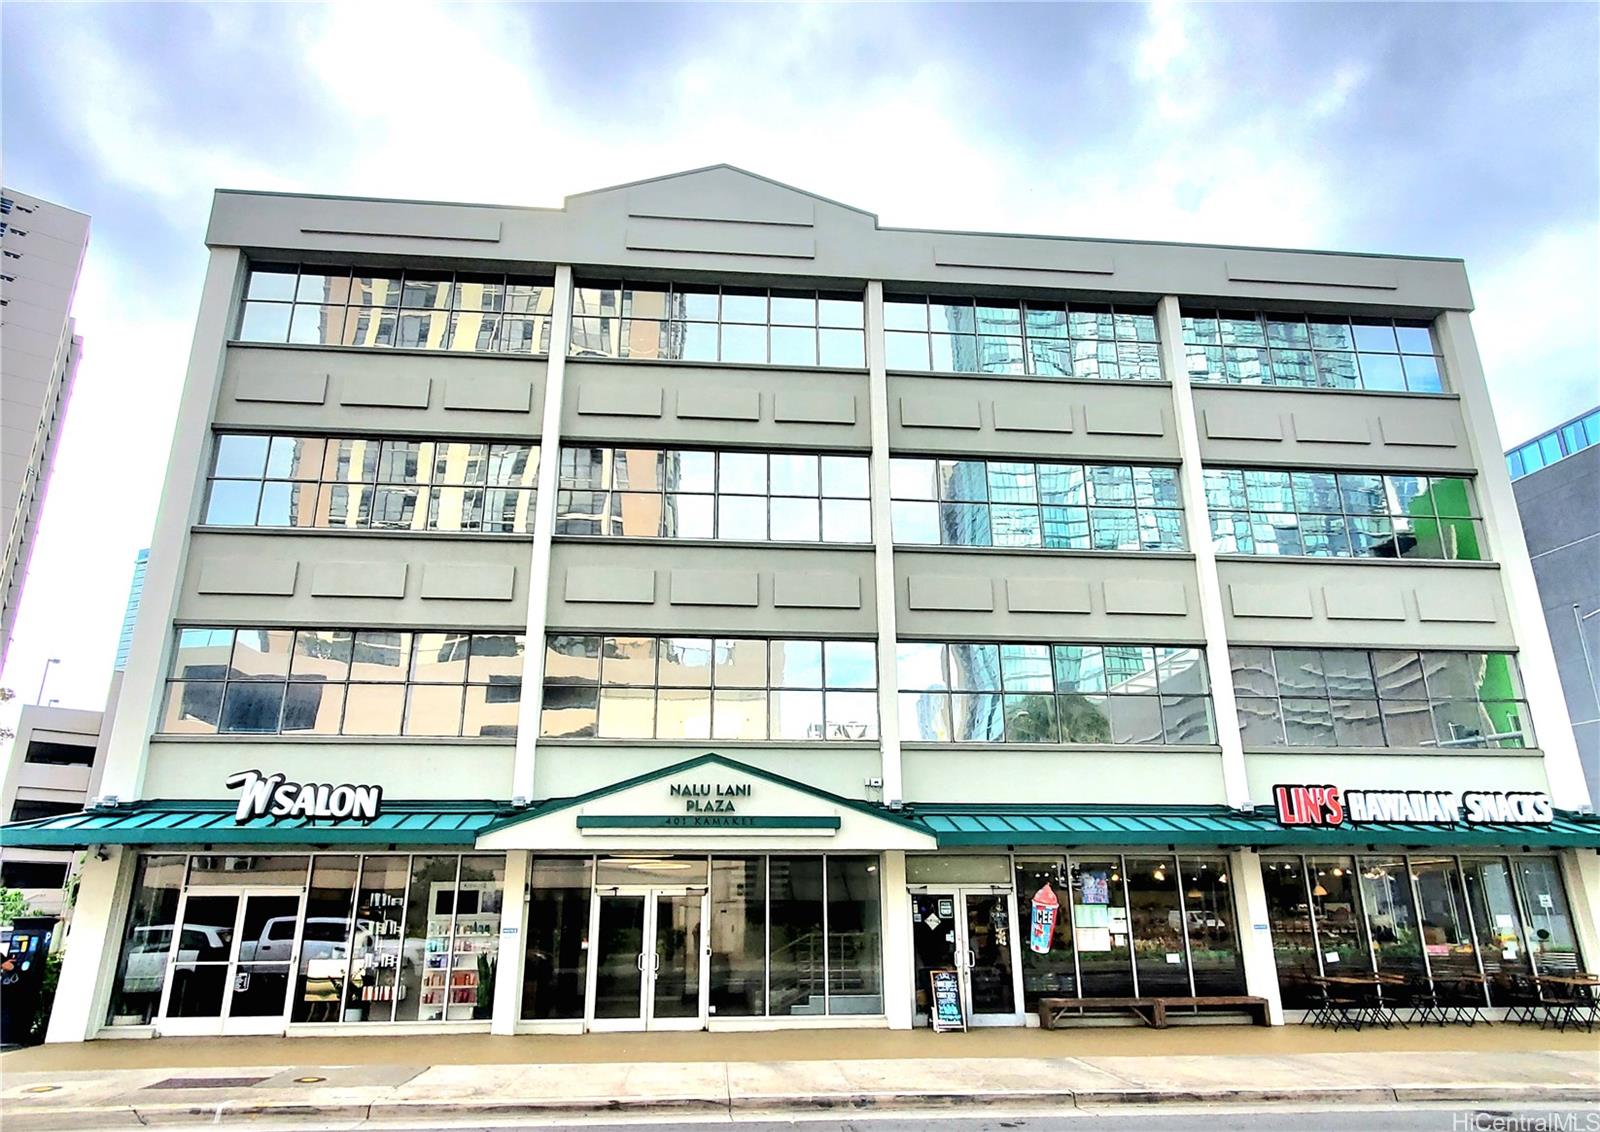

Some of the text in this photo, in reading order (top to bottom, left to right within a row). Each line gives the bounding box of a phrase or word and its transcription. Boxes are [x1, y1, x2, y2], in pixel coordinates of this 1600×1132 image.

[670, 784, 752, 796] NALU LANI
[686, 800, 736, 812] PLAZA
[1275, 786, 1554, 825] LIN'S HAWAIIAN SNACKS
[665, 817, 687, 826] 401
